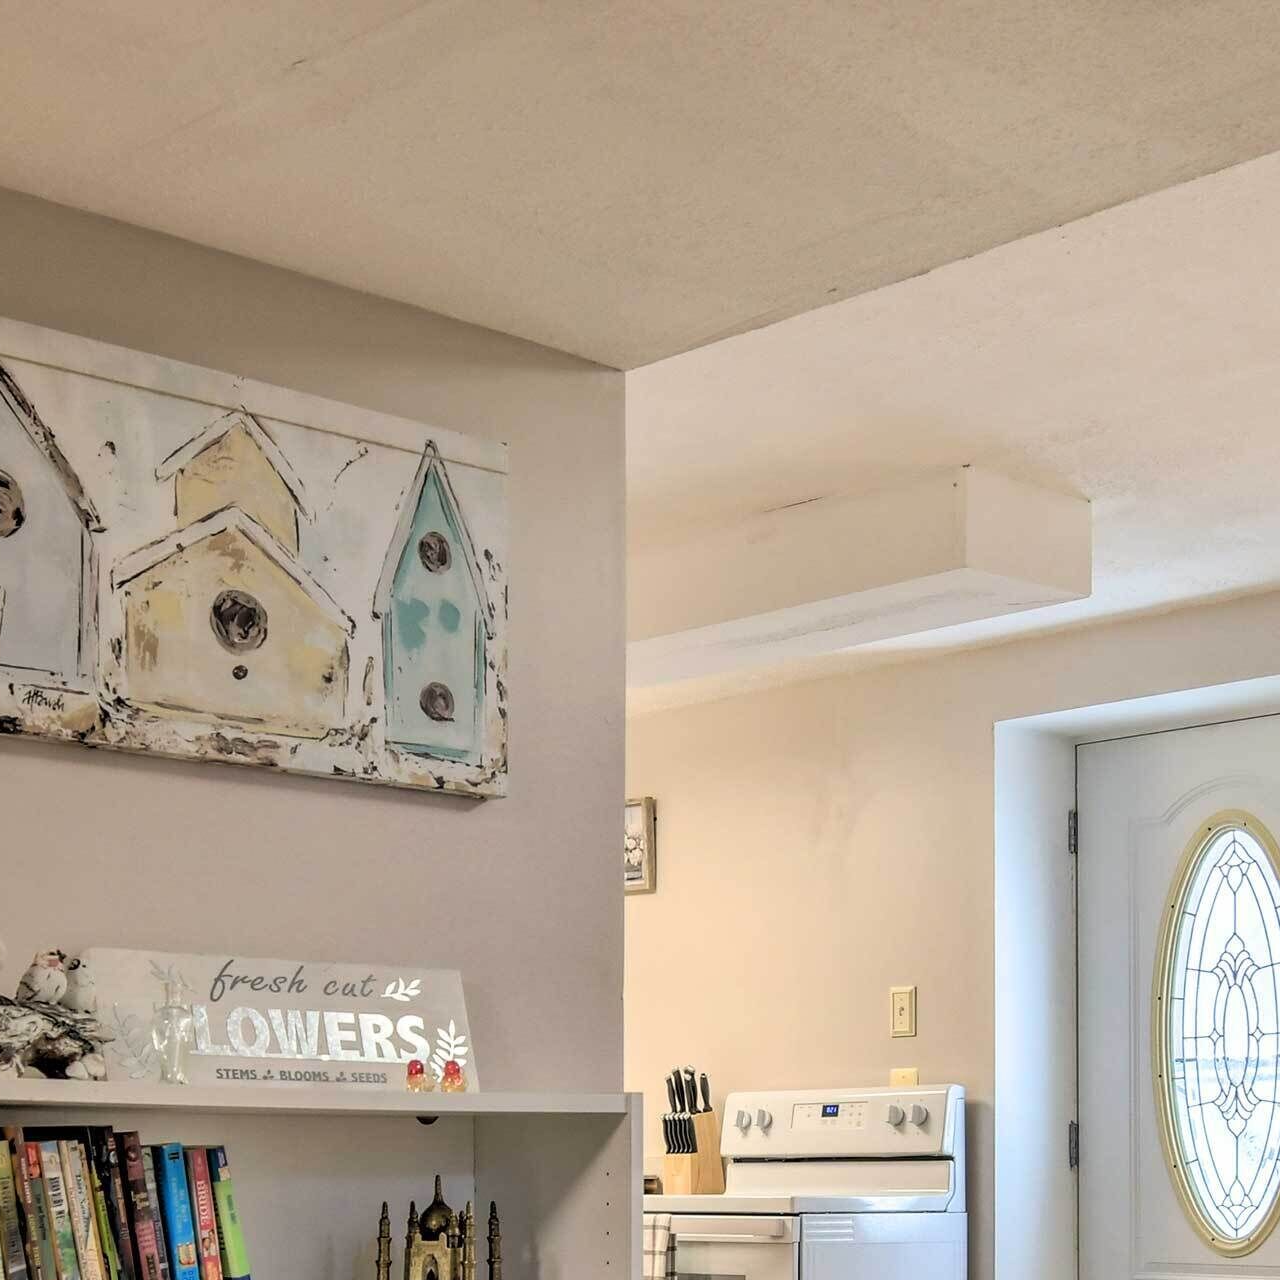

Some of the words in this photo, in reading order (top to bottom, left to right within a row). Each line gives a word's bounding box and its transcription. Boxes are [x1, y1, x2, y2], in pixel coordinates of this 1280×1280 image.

[210, 960, 308, 1002] fresh
[323, 974, 377, 998] cut
[185, 1003, 430, 1063] LOWERS
[216, 1068, 257, 1080] STEMS
[279, 1070, 330, 1082] BLOOMS
[351, 1072, 388, 1084] SEEDS
[195, 1179, 212, 1227] BRIDE
